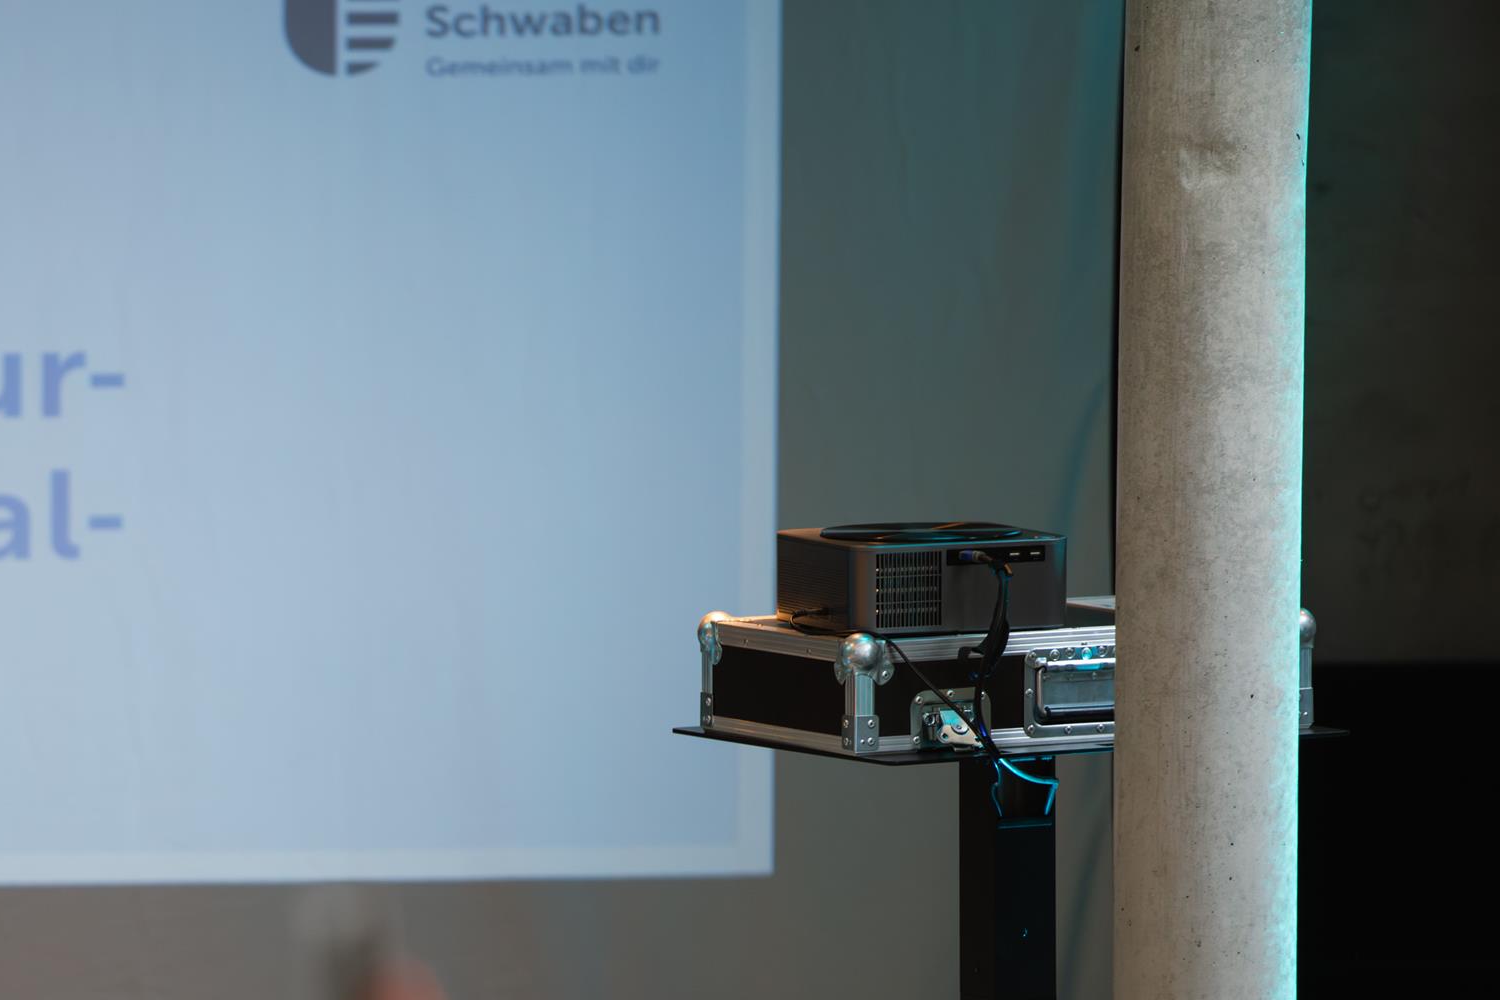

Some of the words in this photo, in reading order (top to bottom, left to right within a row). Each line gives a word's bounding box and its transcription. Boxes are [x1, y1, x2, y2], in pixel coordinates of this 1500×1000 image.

[426, 3, 661, 38] Schwaben
[426, 56, 573, 77] Gemeinsam
[579, 54, 620, 74] mit
[626, 54, 660, 74] dir
